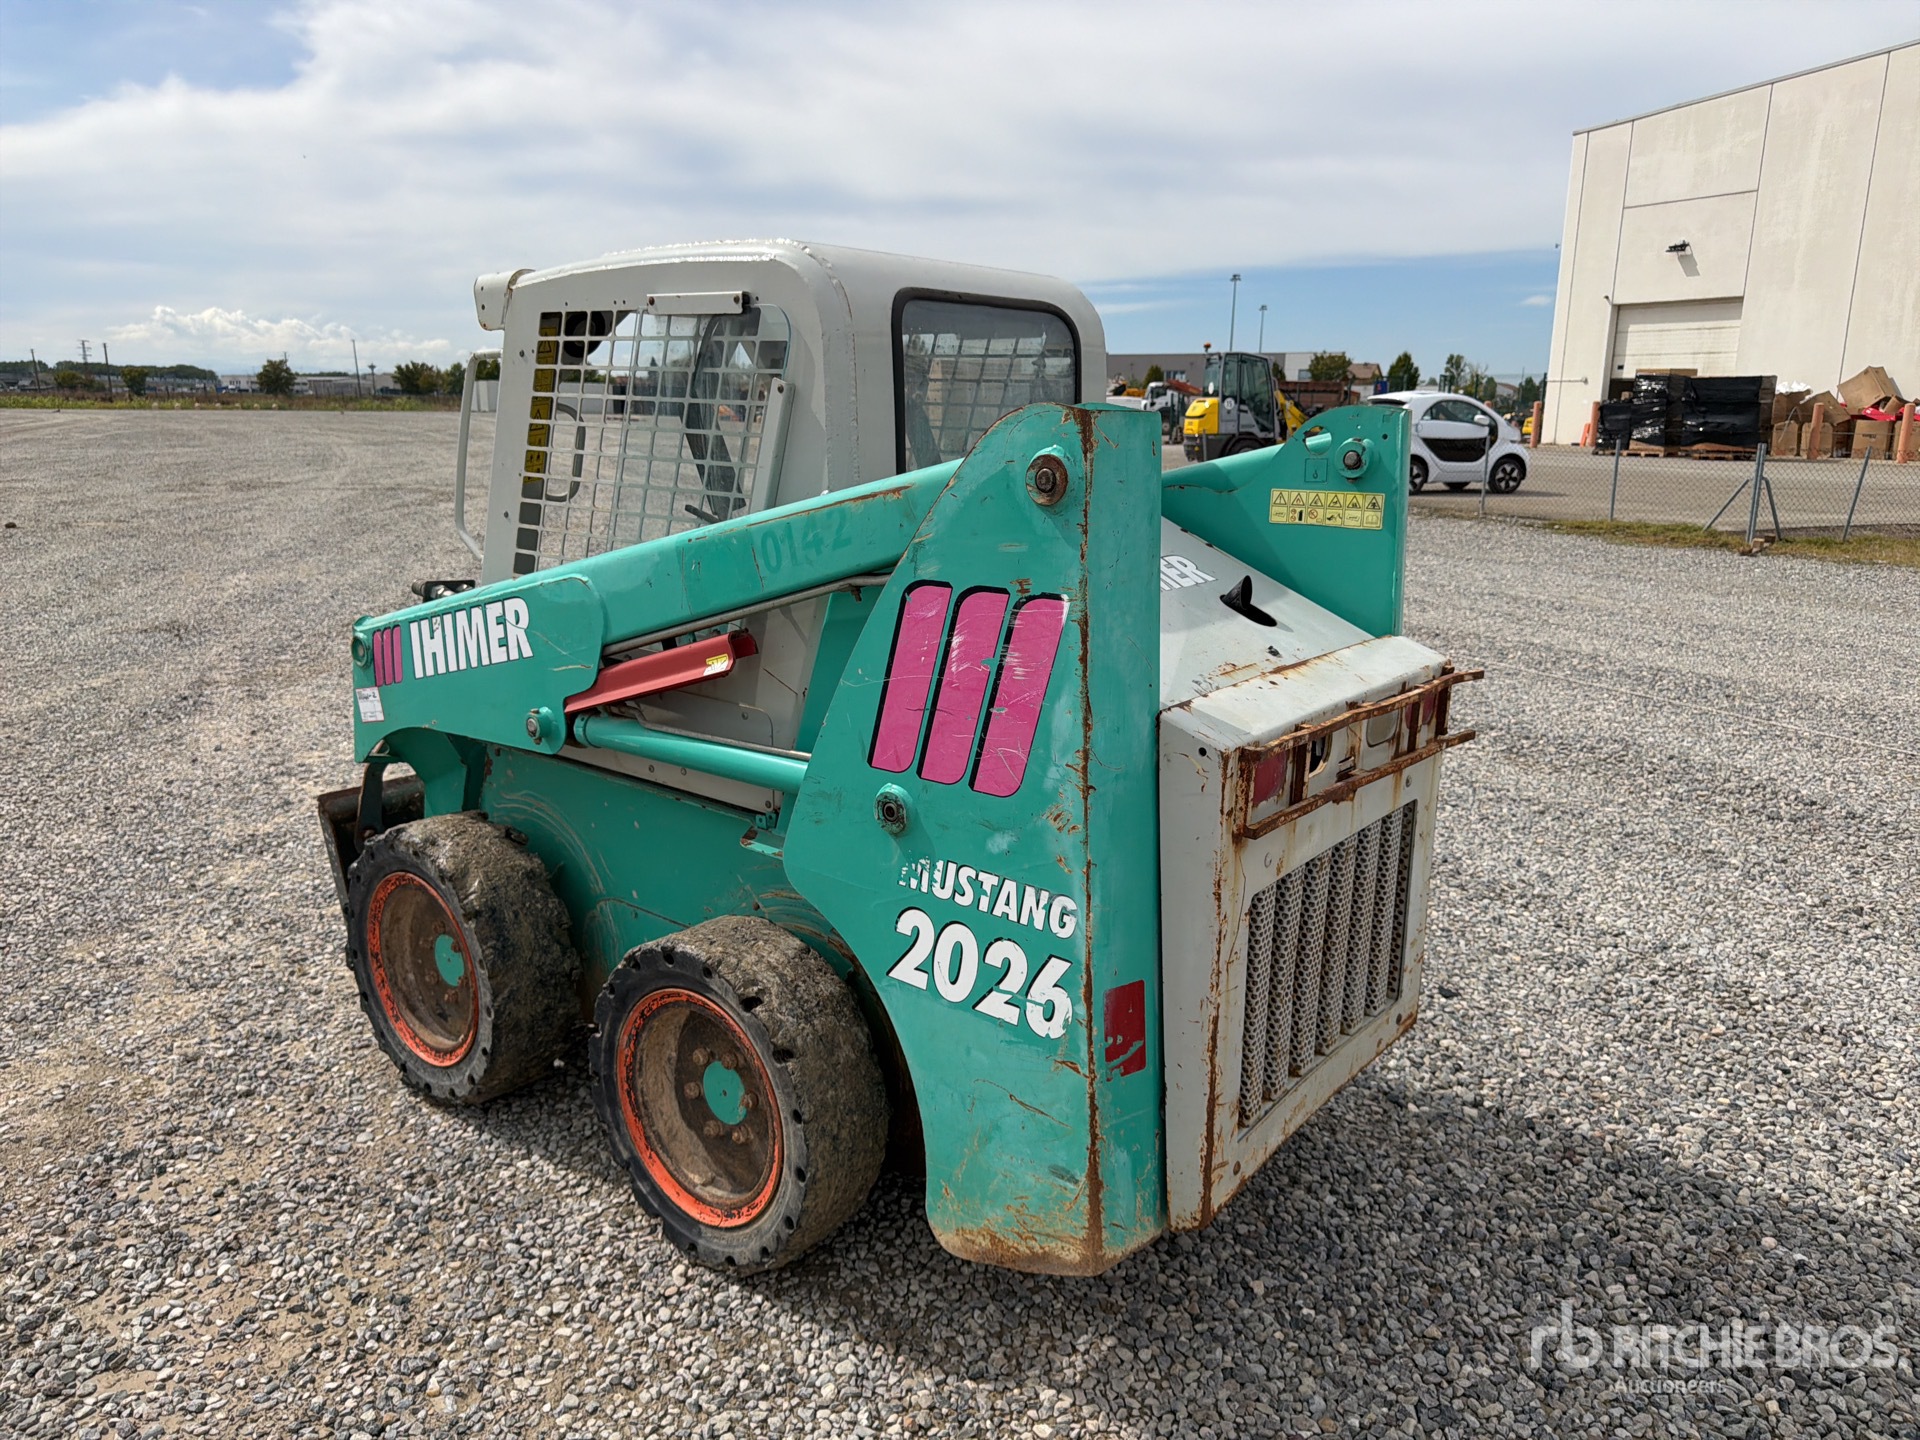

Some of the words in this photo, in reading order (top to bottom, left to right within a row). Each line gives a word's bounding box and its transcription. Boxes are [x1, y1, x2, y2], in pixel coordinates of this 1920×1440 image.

[409, 597, 534, 680] IHIMER
[898, 856, 1078, 939] MUSTANG
[886, 906, 1073, 1039] 2026
